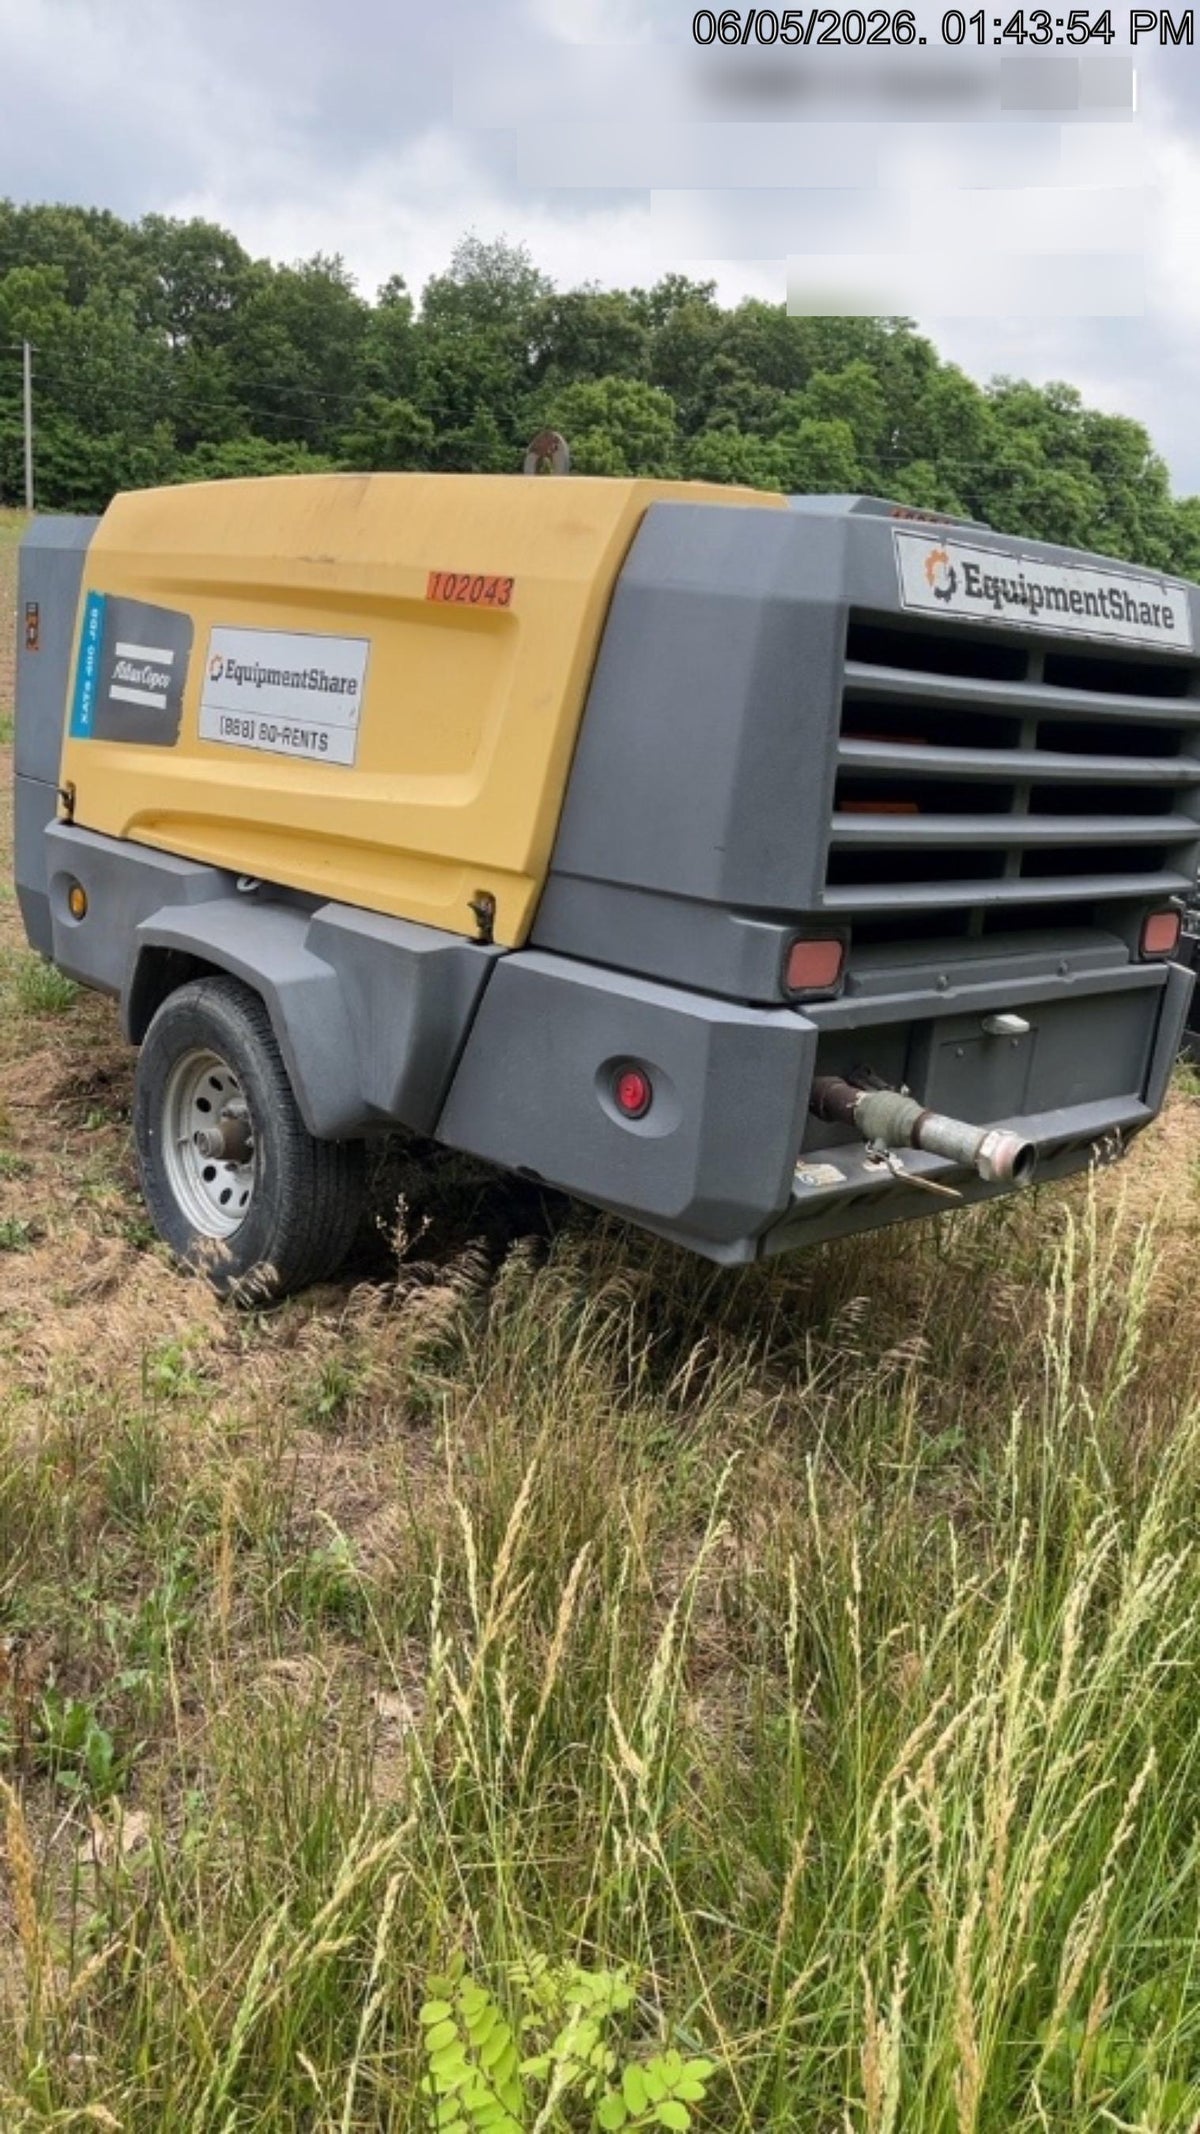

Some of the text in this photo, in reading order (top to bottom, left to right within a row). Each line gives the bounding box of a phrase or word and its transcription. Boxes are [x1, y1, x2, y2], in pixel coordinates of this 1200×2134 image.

[431, 573, 515, 605] 102043
[961, 562, 1176, 630] EquipmentShare
[224, 658, 358, 696] EquipmentShare
